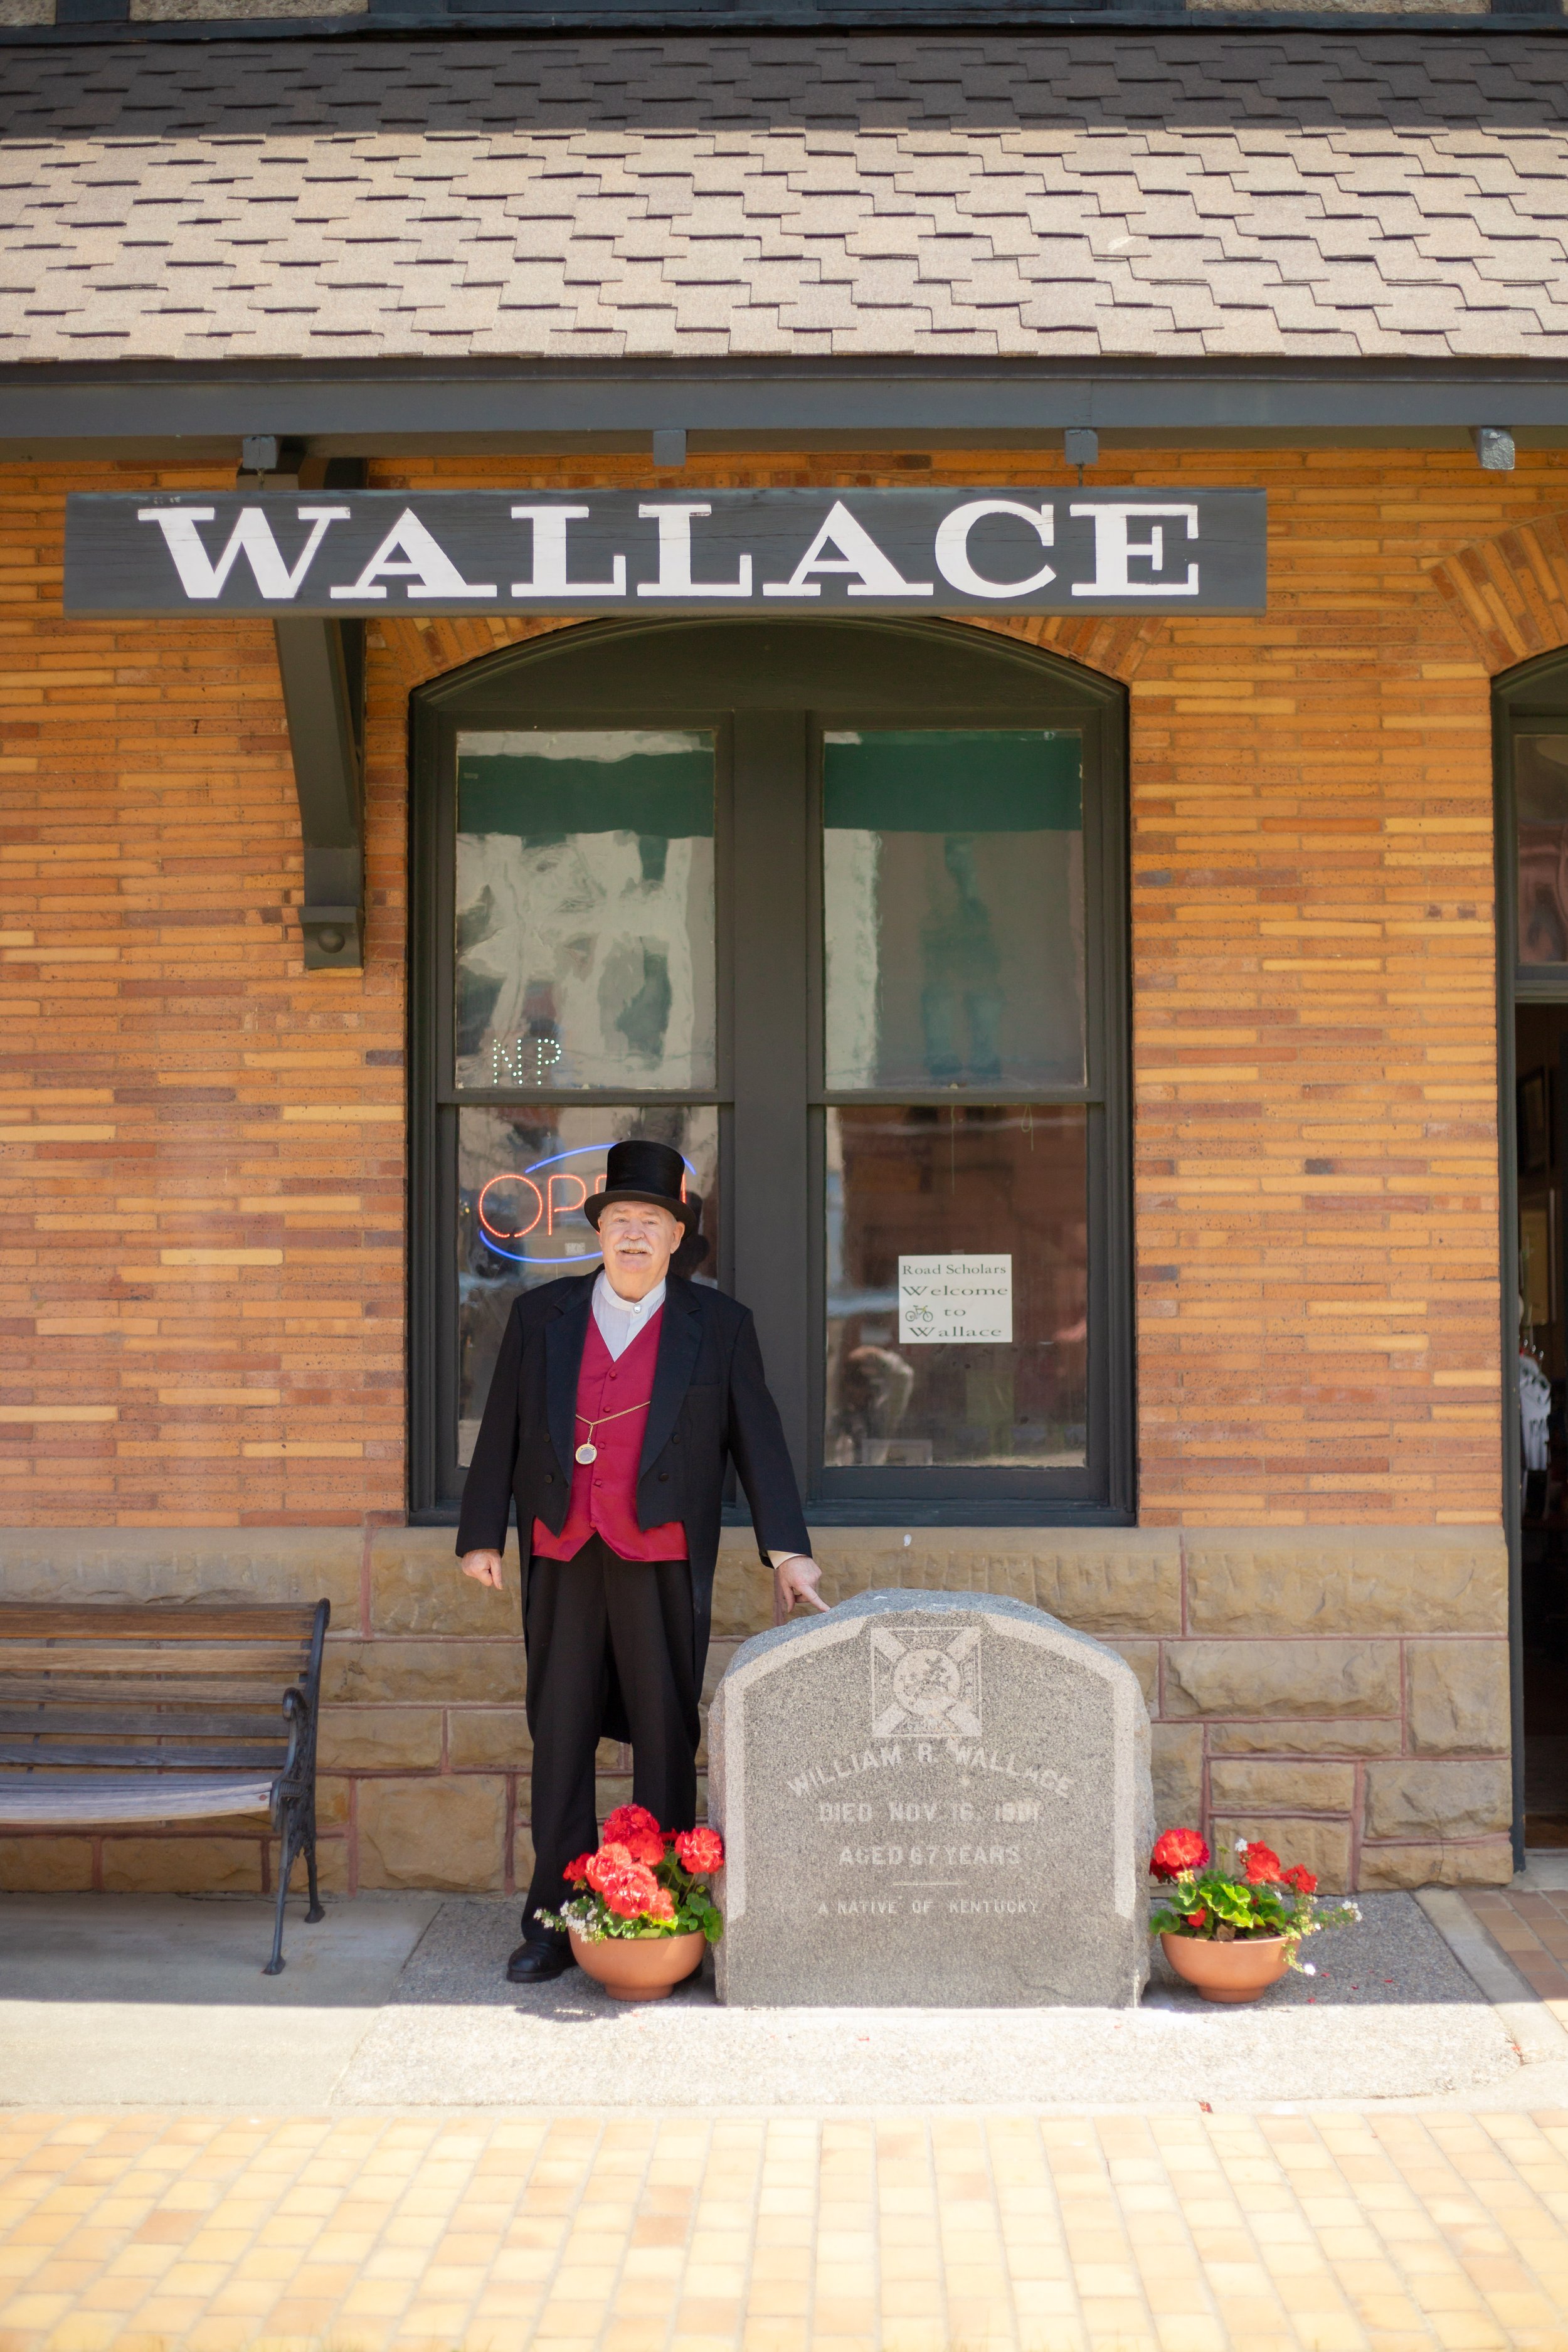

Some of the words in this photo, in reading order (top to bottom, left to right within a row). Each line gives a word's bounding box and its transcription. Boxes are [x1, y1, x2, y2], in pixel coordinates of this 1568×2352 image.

[137, 500, 1199, 598] WALLACE
[903, 1264, 941, 1275] Road
[946, 1264, 1007, 1274] Scholars
[902, 1285, 1009, 1296] Welcome
[943, 1308, 967, 1317] to
[908, 1326, 1002, 1337] Wallace
[785, 1744, 902, 1798] WILLIAM
[952, 1745, 1074, 1799] WALLACE
[818, 1801, 874, 1823] DIED
[839, 1845, 904, 1865] AGED
[909, 1845, 940, 1865] 67
[945, 1845, 1021, 1865] YEARS
[817, 1900, 829, 1914] A
[837, 1900, 898, 1914] NATIVE
[911, 1900, 934, 1914] OF
